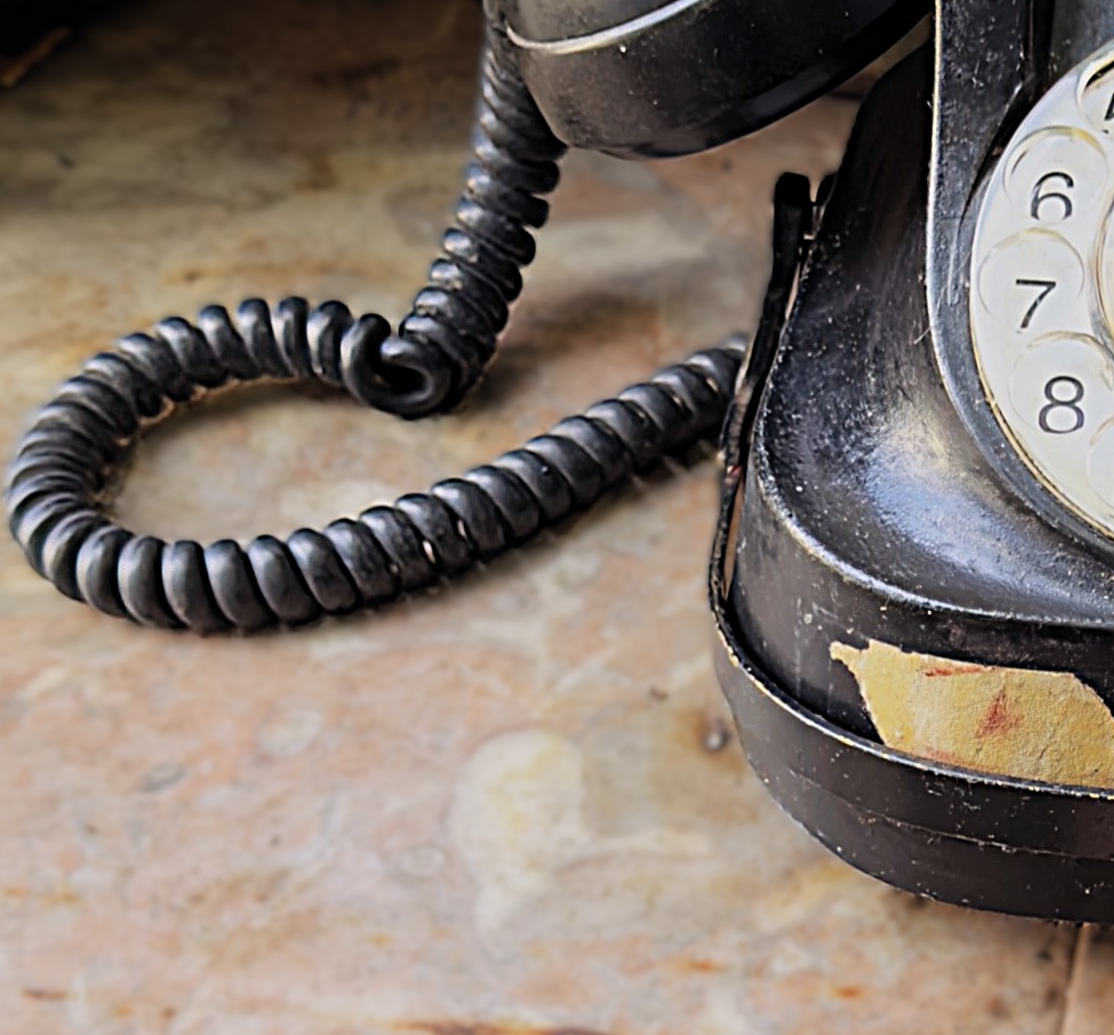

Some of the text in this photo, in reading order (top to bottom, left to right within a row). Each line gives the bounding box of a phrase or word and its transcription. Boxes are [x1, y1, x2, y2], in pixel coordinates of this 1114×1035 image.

[1031, 172, 1073, 219] 6
[1015, 278, 1057, 329] 7
[1039, 376, 1085, 434] 8
